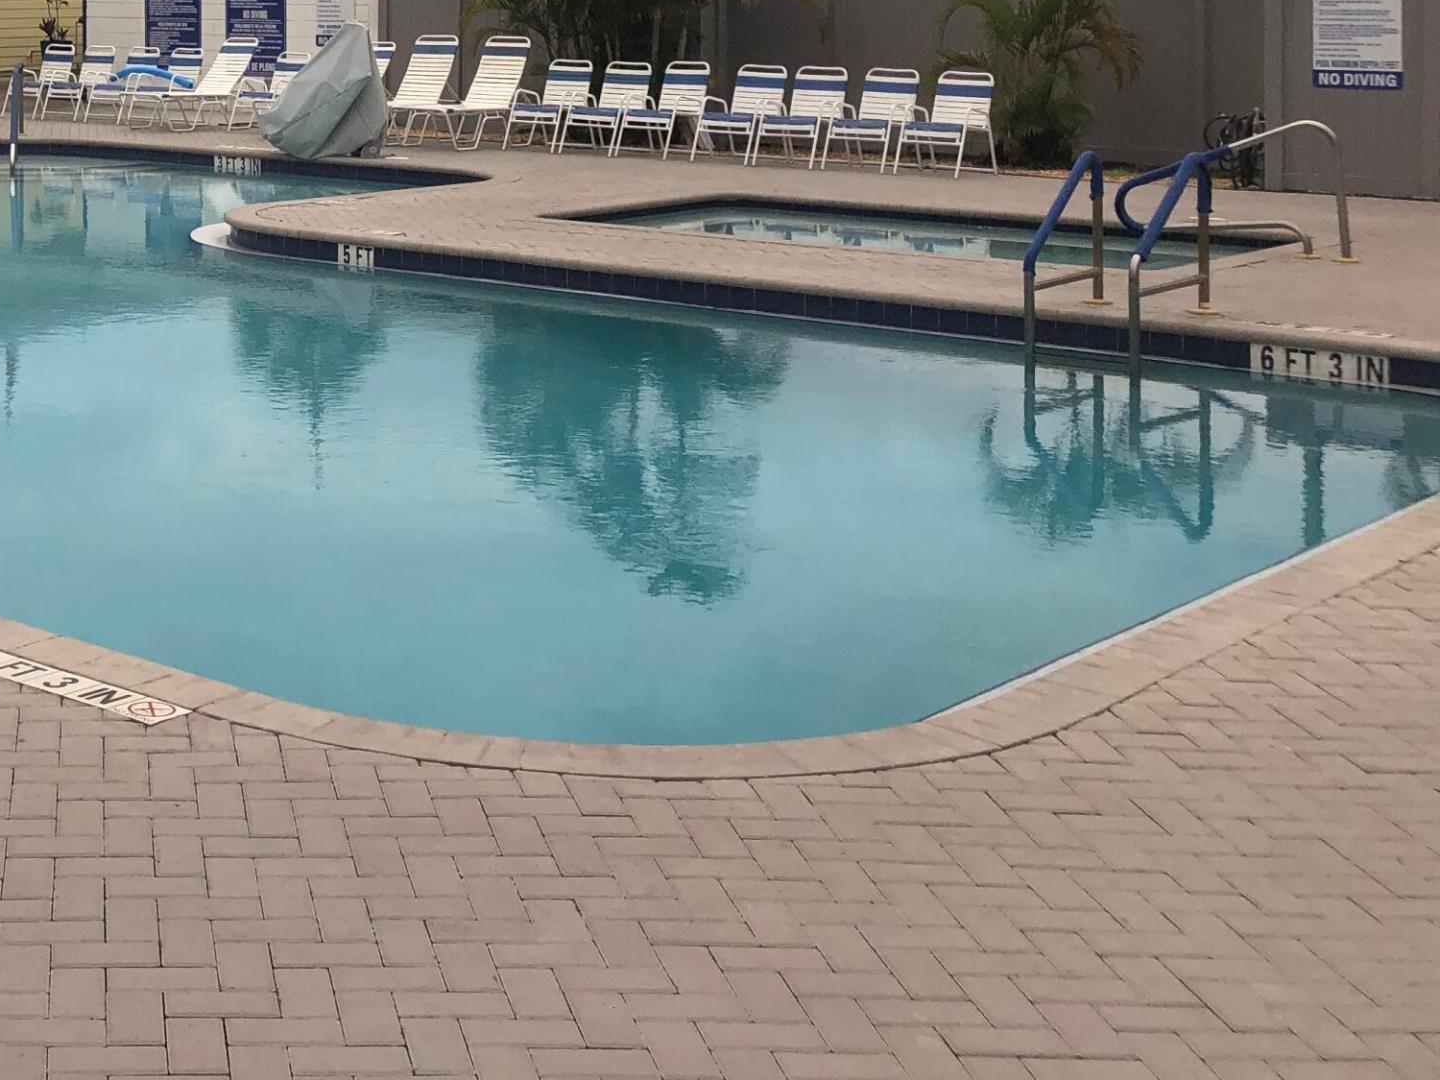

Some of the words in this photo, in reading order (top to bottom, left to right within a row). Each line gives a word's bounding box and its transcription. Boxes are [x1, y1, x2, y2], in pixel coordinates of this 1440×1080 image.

[1318, 72, 1340, 86] NO
[1343, 73, 1398, 88] DIVING
[226, 156, 238, 169] FT
[249, 158, 259, 171] IN
[343, 245, 350, 264] 5
[356, 247, 373, 267] FT
[1261, 345, 1274, 371] 6
[1285, 348, 1316, 375] FT
[1329, 352, 1342, 379] 3
[1356, 356, 1384, 384] IN
[42, 677, 80, 689] 3
[77, 687, 132, 705] IN
